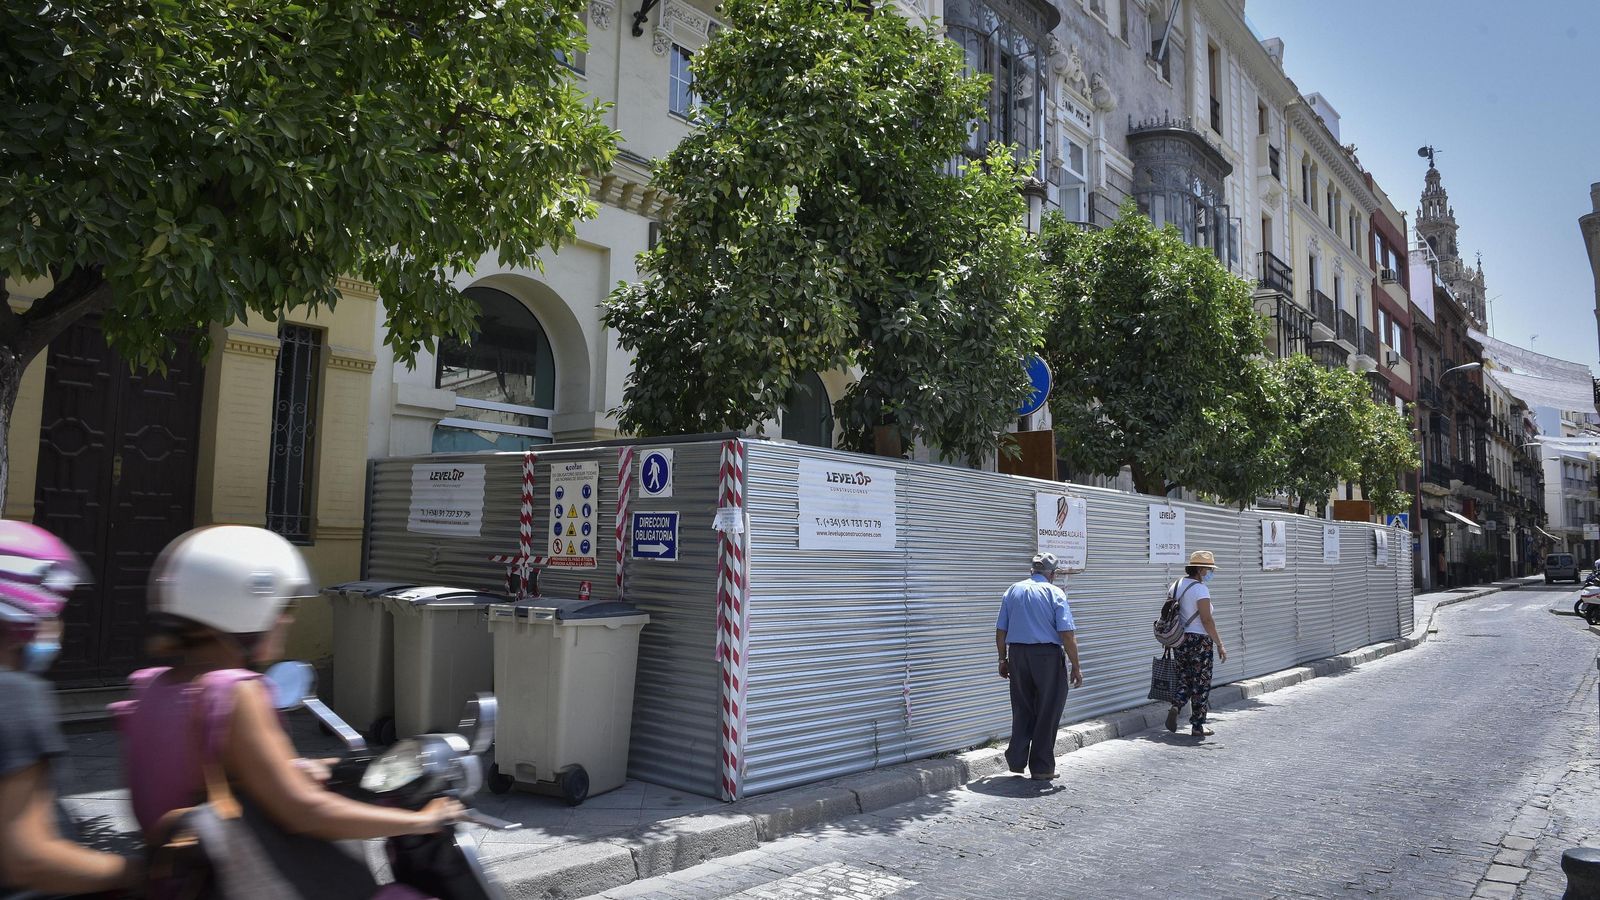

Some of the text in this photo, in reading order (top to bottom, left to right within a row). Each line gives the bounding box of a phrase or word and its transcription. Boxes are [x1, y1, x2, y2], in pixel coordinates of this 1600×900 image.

[430, 468, 464, 480] LEVELUP
[826, 471, 872, 486] LEVELUP
[640, 516, 670, 528] DIRECCION
[850, 519, 863, 528] 737
[863, 519, 872, 528] 57
[873, 520, 882, 529] 79
[635, 530, 673, 540] OBLIGATORIA
